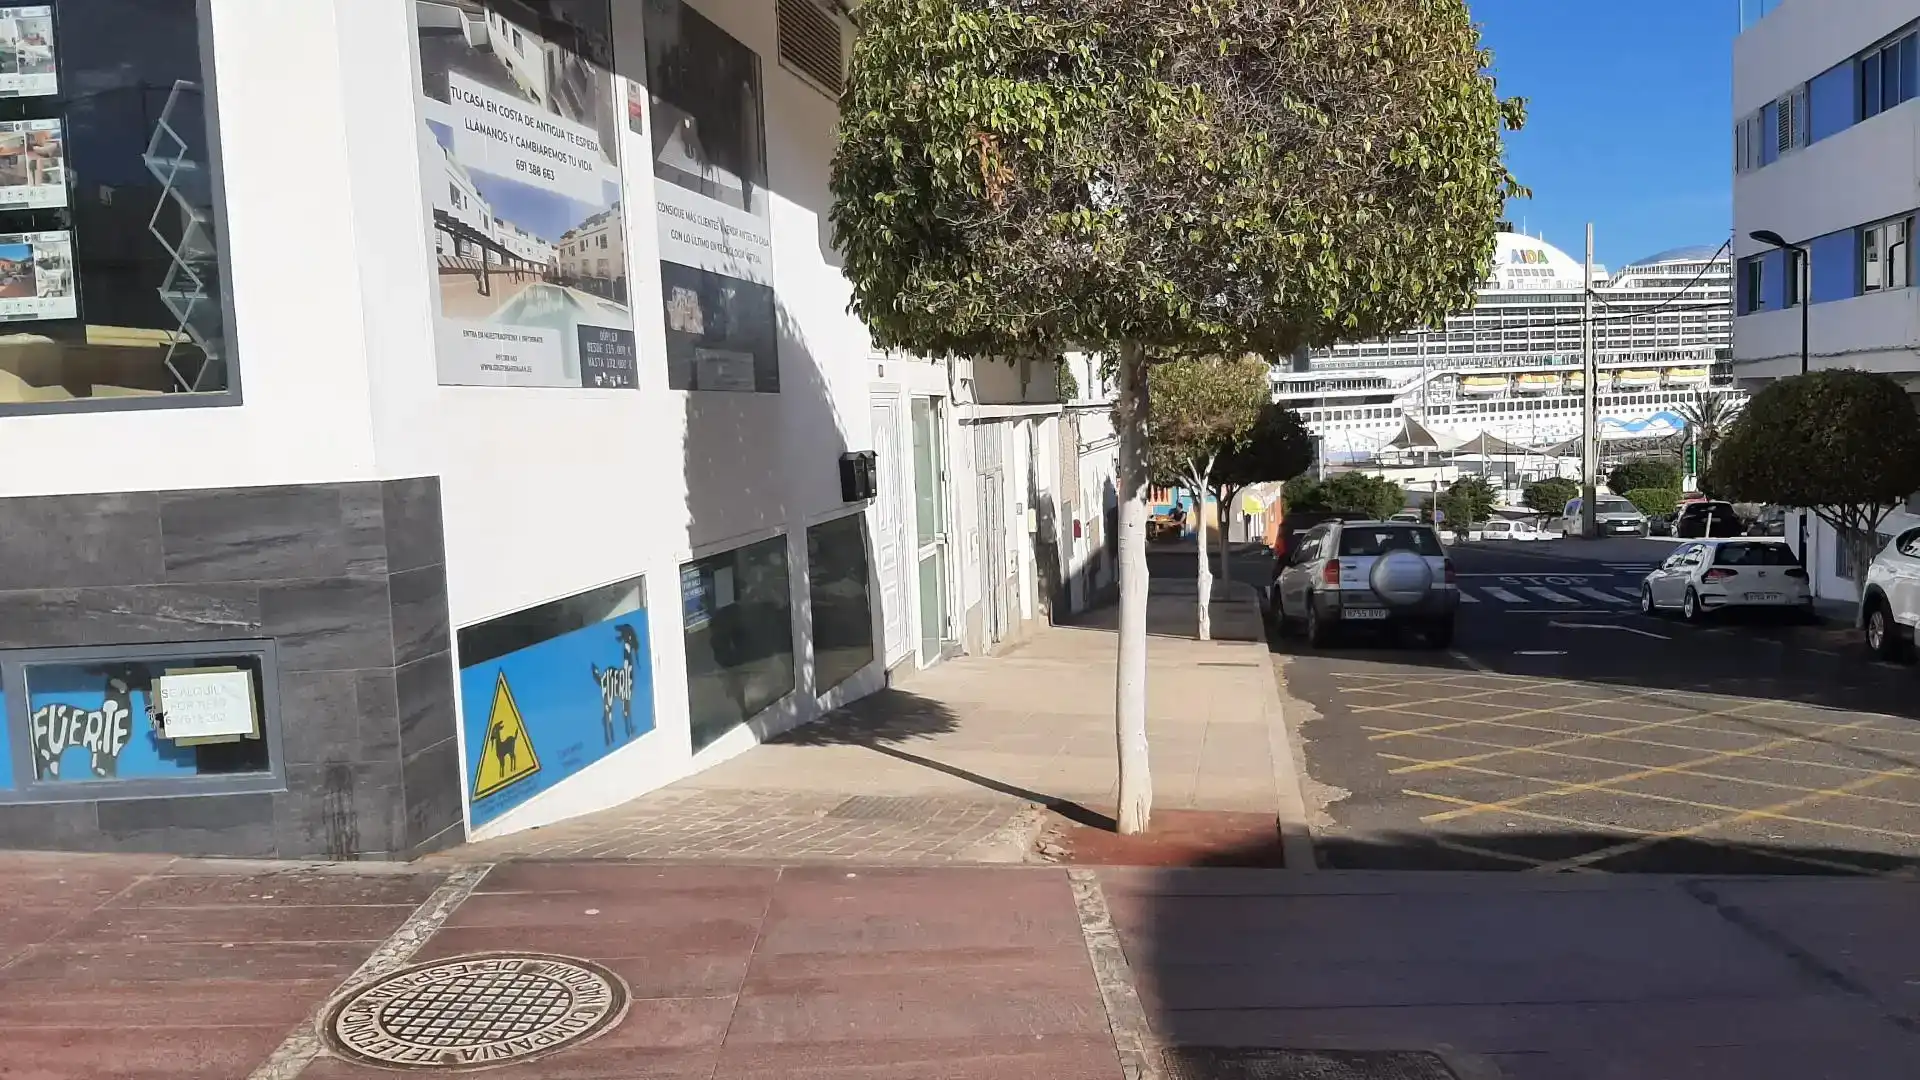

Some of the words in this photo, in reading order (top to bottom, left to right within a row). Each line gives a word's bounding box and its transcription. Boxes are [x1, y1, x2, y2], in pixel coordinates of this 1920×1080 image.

[451, 86, 462, 100] TU
[463, 91, 485, 110] CASA
[487, 101, 497, 115] EN
[499, 105, 523, 124] COSTA
[524, 115, 535, 129] DE
[536, 120, 566, 140] ANTIGUA
[566, 131, 575, 144] TE
[575, 136, 599, 152] ESPERA
[508, 132, 514, 144] Y
[515, 136, 567, 164] CAMBIAREMOS
[568, 155, 577, 167] TU
[577, 159, 593, 172] VIDA
[515, 159, 527, 172] 691
[529, 162, 541, 176] 388
[542, 167, 555, 181] 663
[657, 201, 685, 220] CONSIGUE
[697, 215, 720, 231] CLIENTES
[671, 228, 683, 242] CON
[684, 232, 691, 244] LO
[1511, 248, 1550, 264] AIDA
[1497, 576, 1589, 585] STOP
[33, 700, 129, 757] FUERTE
[487, 960, 523, 971] DE
